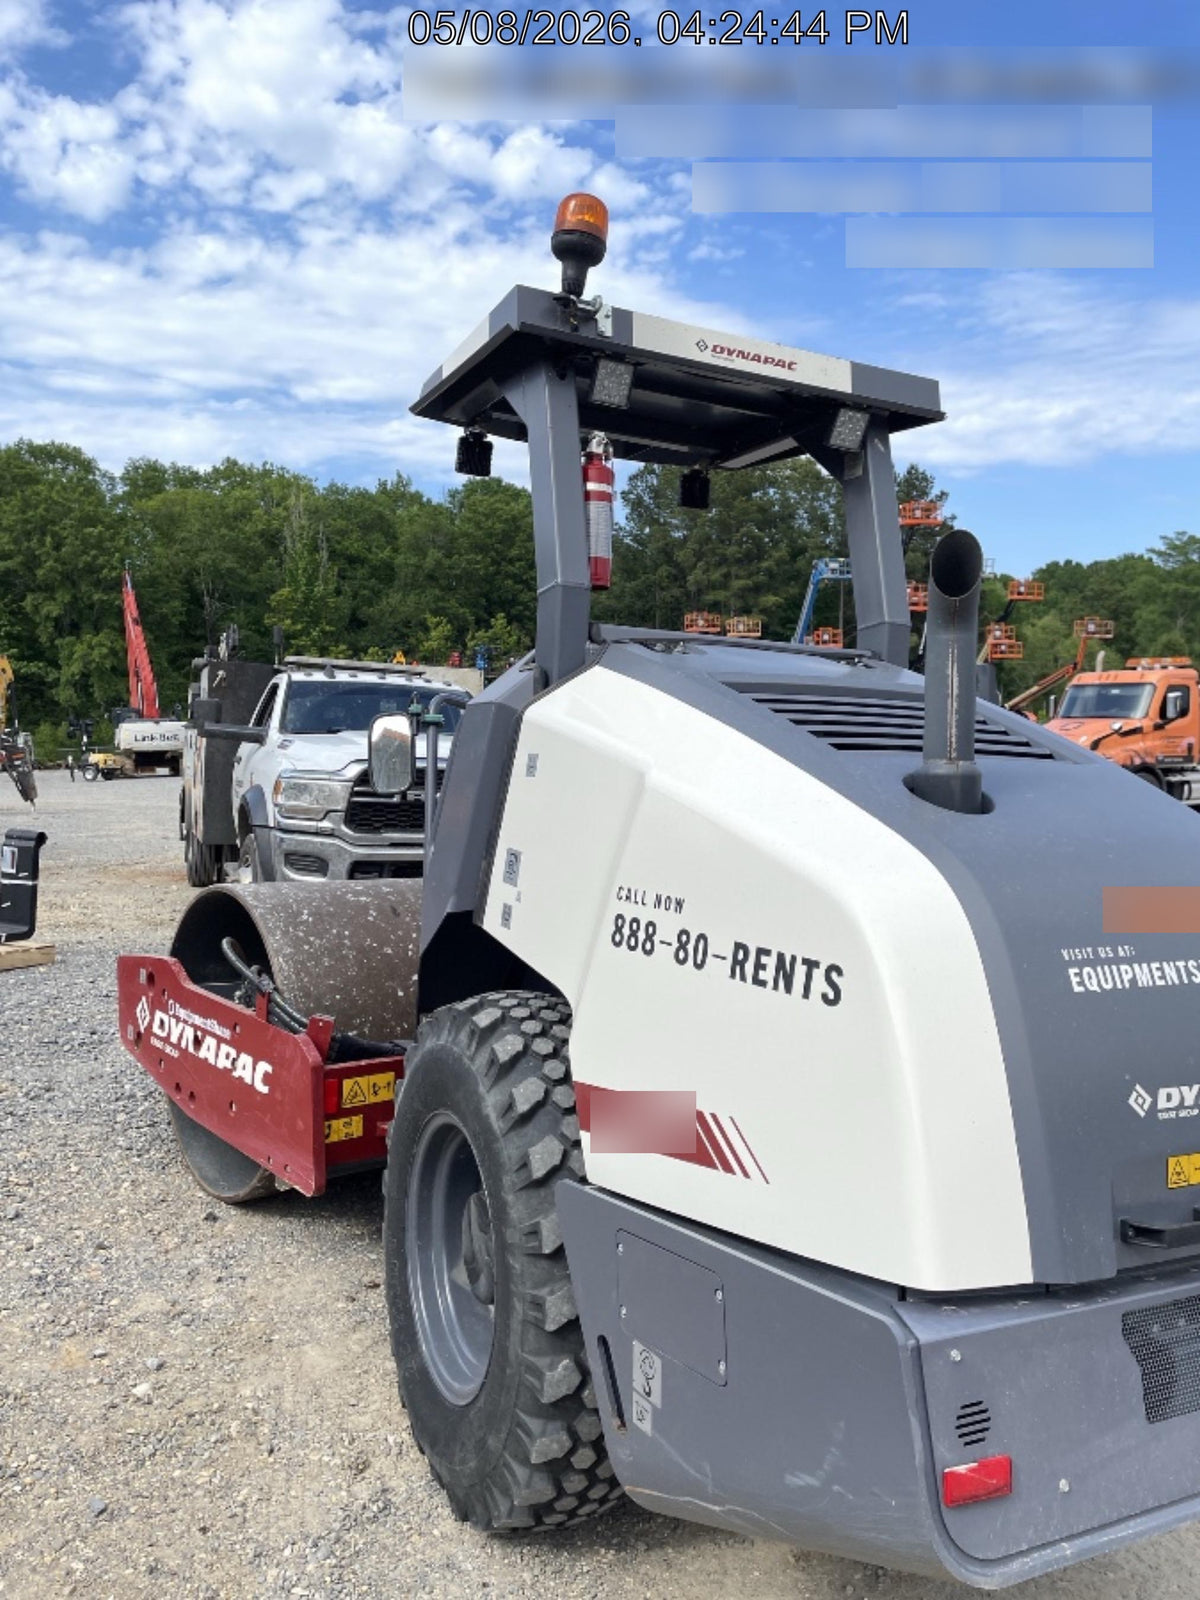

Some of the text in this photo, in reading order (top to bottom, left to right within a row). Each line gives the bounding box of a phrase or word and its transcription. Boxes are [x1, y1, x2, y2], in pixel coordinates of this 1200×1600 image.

[711, 344, 797, 371] DYNAPAC
[616, 885, 685, 914] CALL NOW
[611, 914, 844, 1007] 888-80-RENTS
[1061, 945, 1135, 960] VISIT US AT:
[1068, 959, 1200, 992] EQUIPMENTS
[152, 1009, 272, 1094] DYNAPAC
[1157, 1084, 1200, 1110] DY
